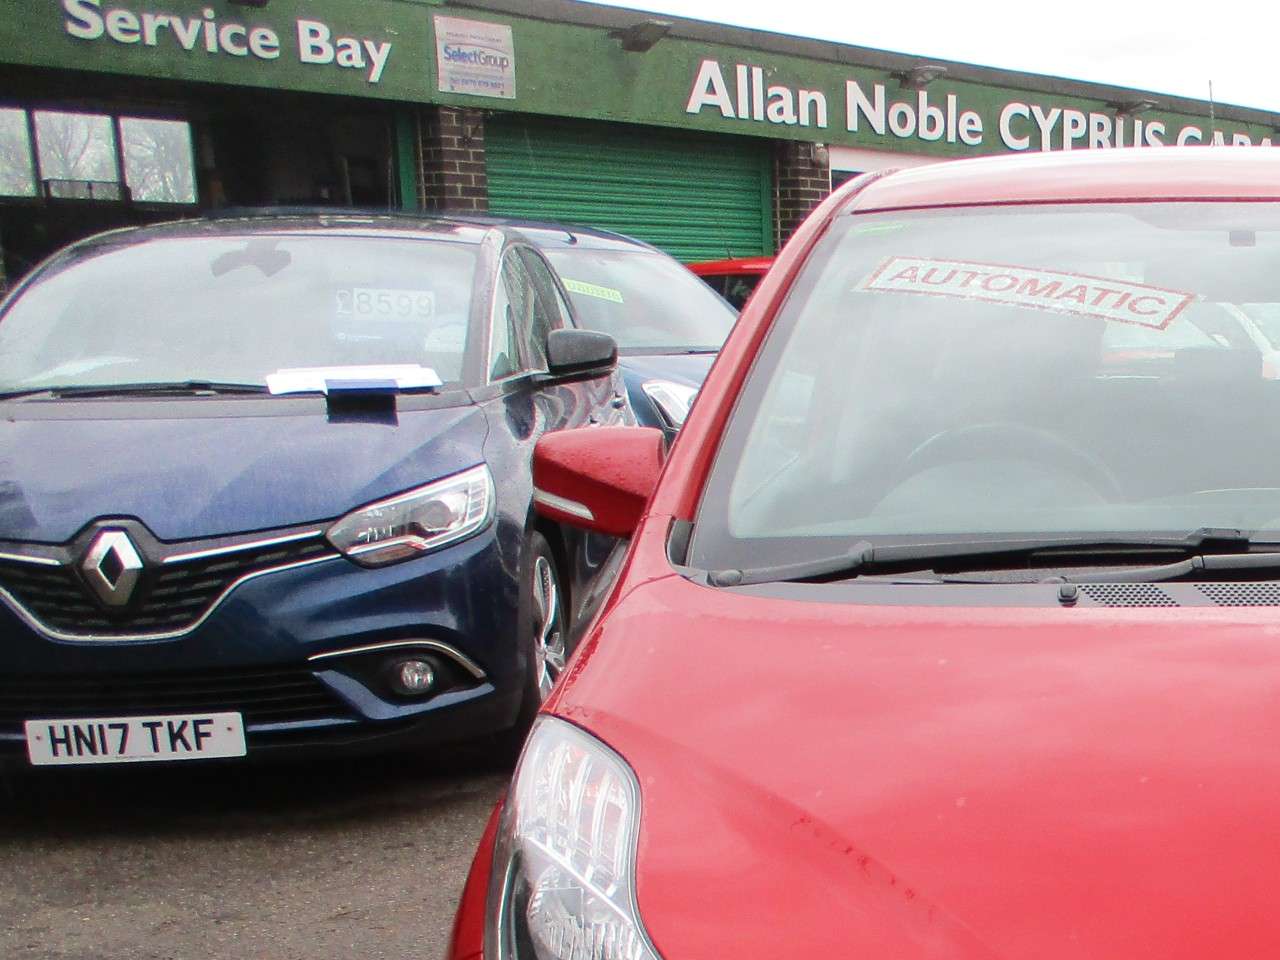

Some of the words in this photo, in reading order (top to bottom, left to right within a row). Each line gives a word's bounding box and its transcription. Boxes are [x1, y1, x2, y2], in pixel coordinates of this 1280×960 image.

[64, 0, 280, 59] Service
[297, 19, 392, 83] Bay
[686, 59, 828, 128] Allan
[846, 80, 984, 146] Noble
[888, 265, 1167, 316] AUTOMATIC
[48, 723, 129, 757] HN17
[142, 719, 214, 753] TKF
